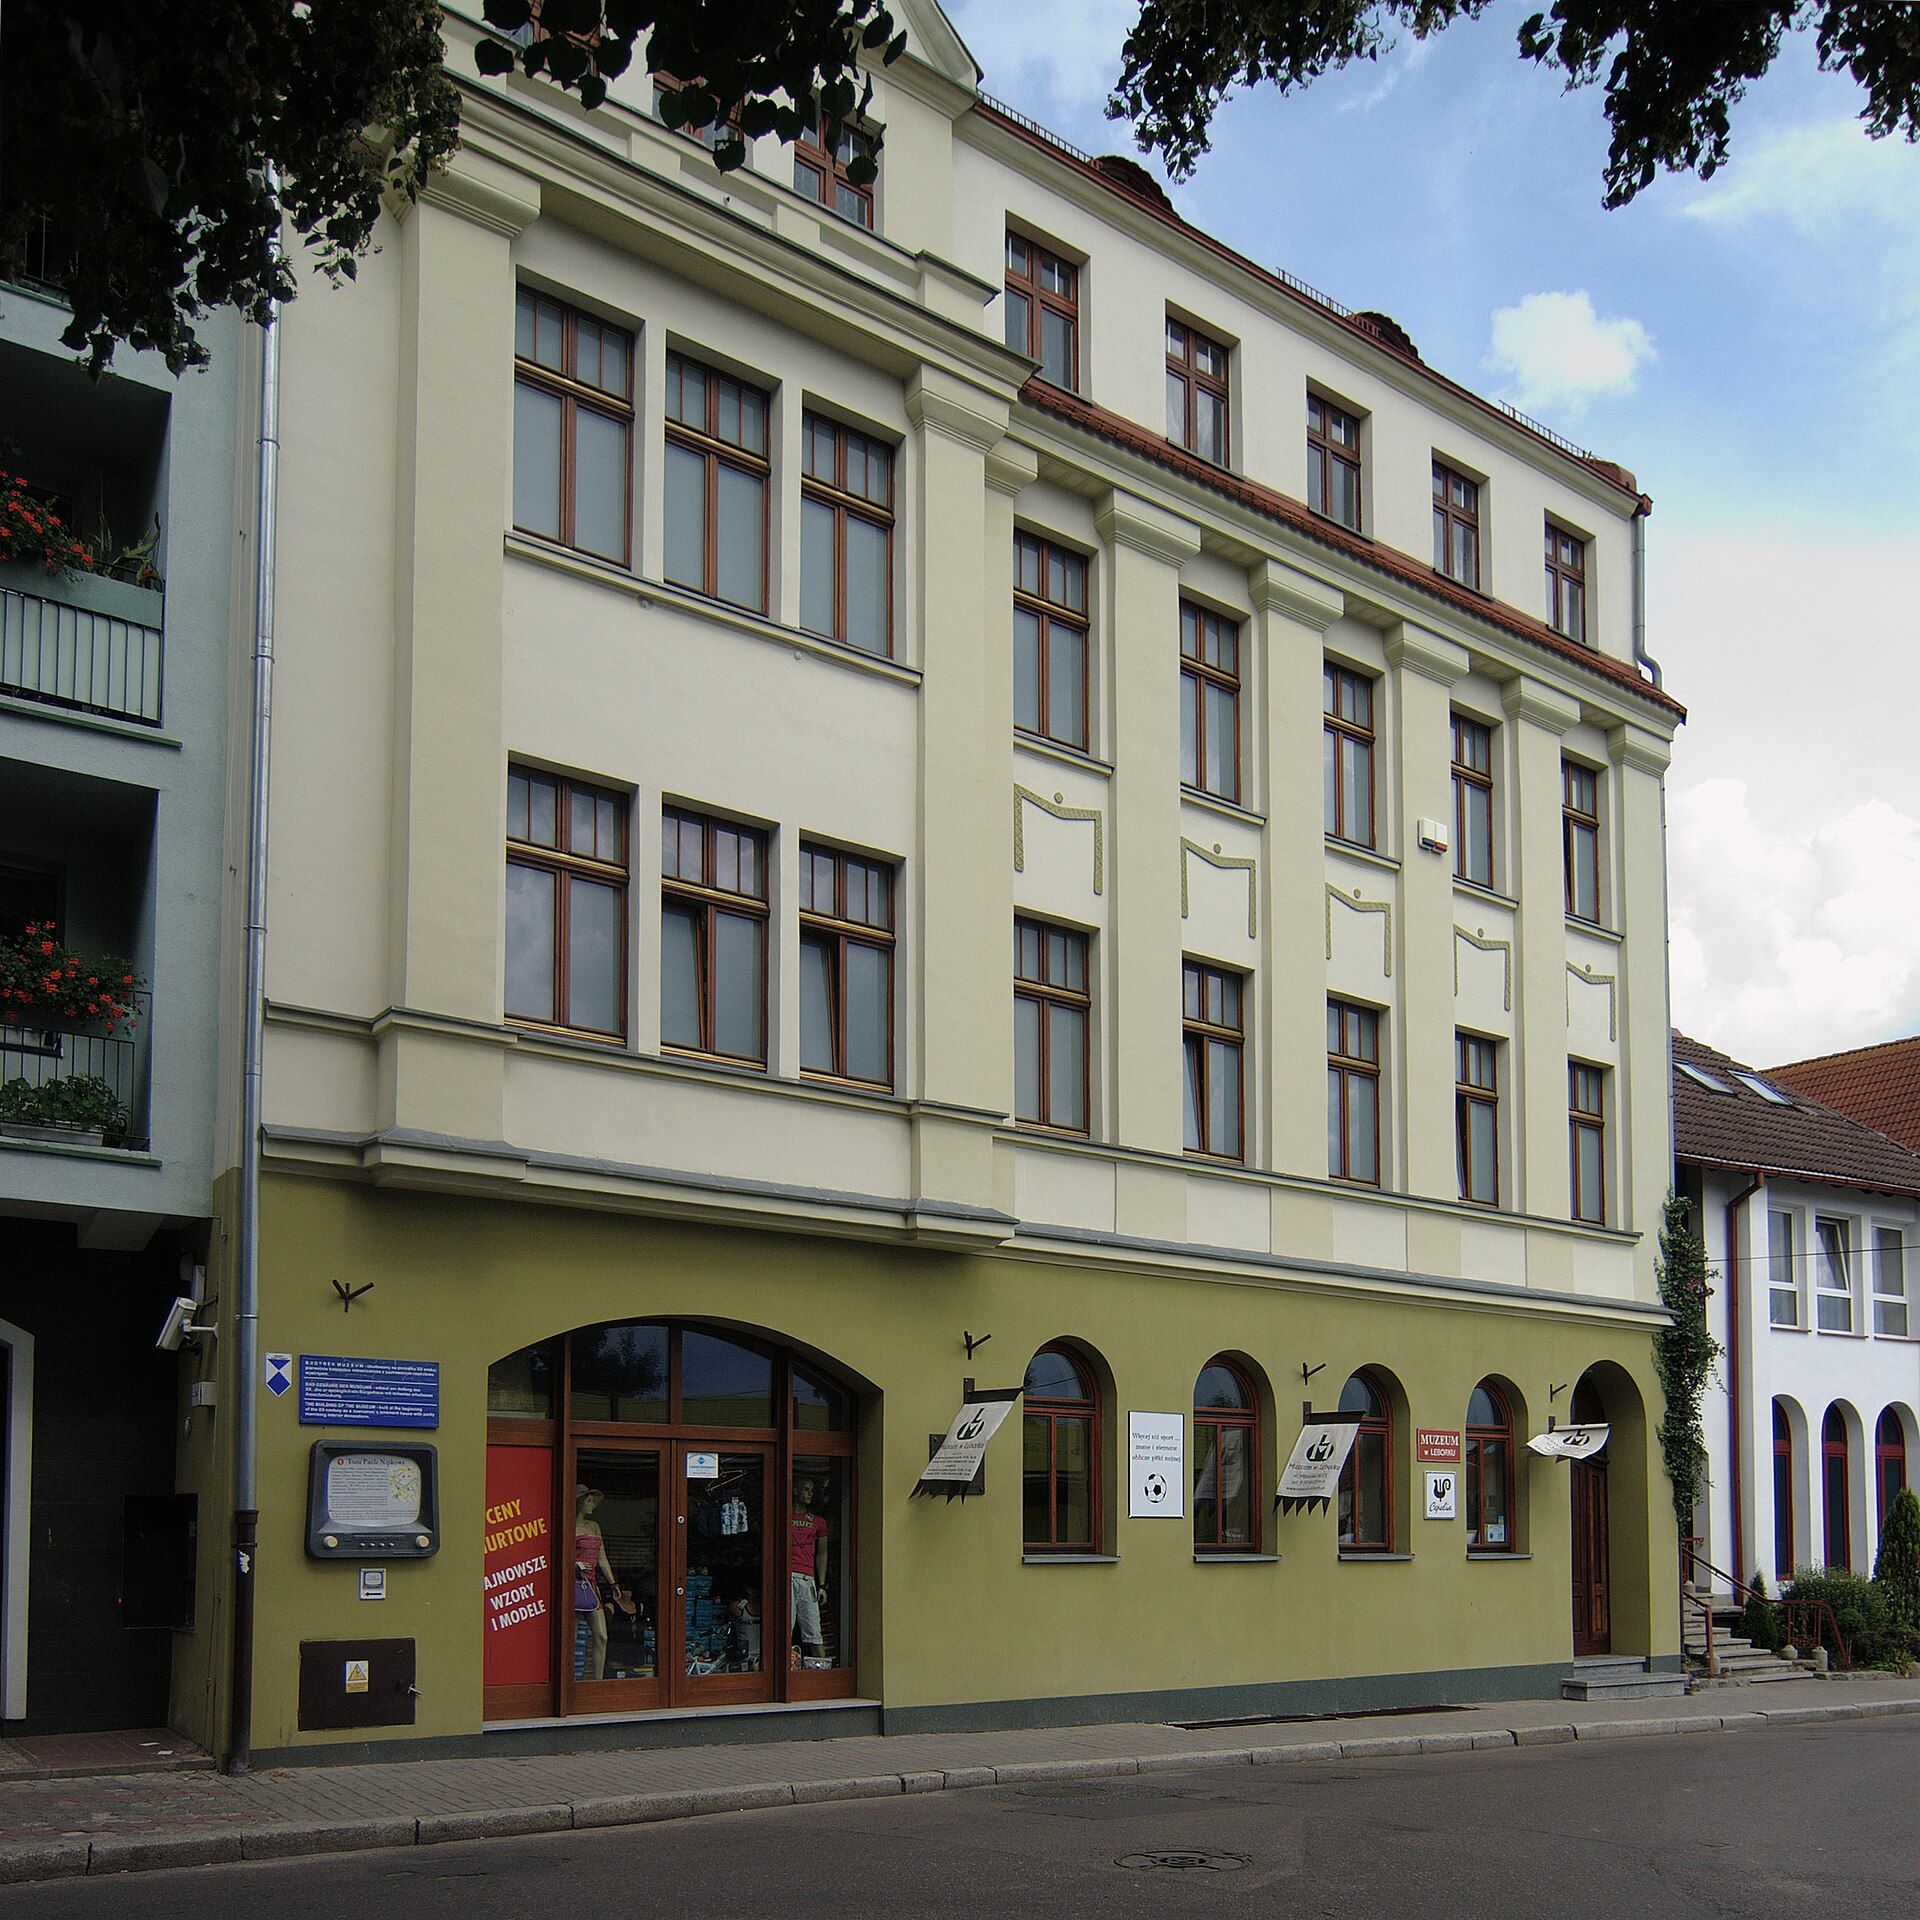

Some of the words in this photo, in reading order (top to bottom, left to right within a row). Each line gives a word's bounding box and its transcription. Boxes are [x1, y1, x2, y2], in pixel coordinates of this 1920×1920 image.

[1420, 1433, 1460, 1446] MUZEUM
[485, 1498, 522, 1525] CENY
[482, 1555, 548, 1591] AJNOWSZE
[490, 1583, 535, 1611] WZORY
[491, 1617, 499, 1632] I
[499, 1599, 547, 1629] MODELE
